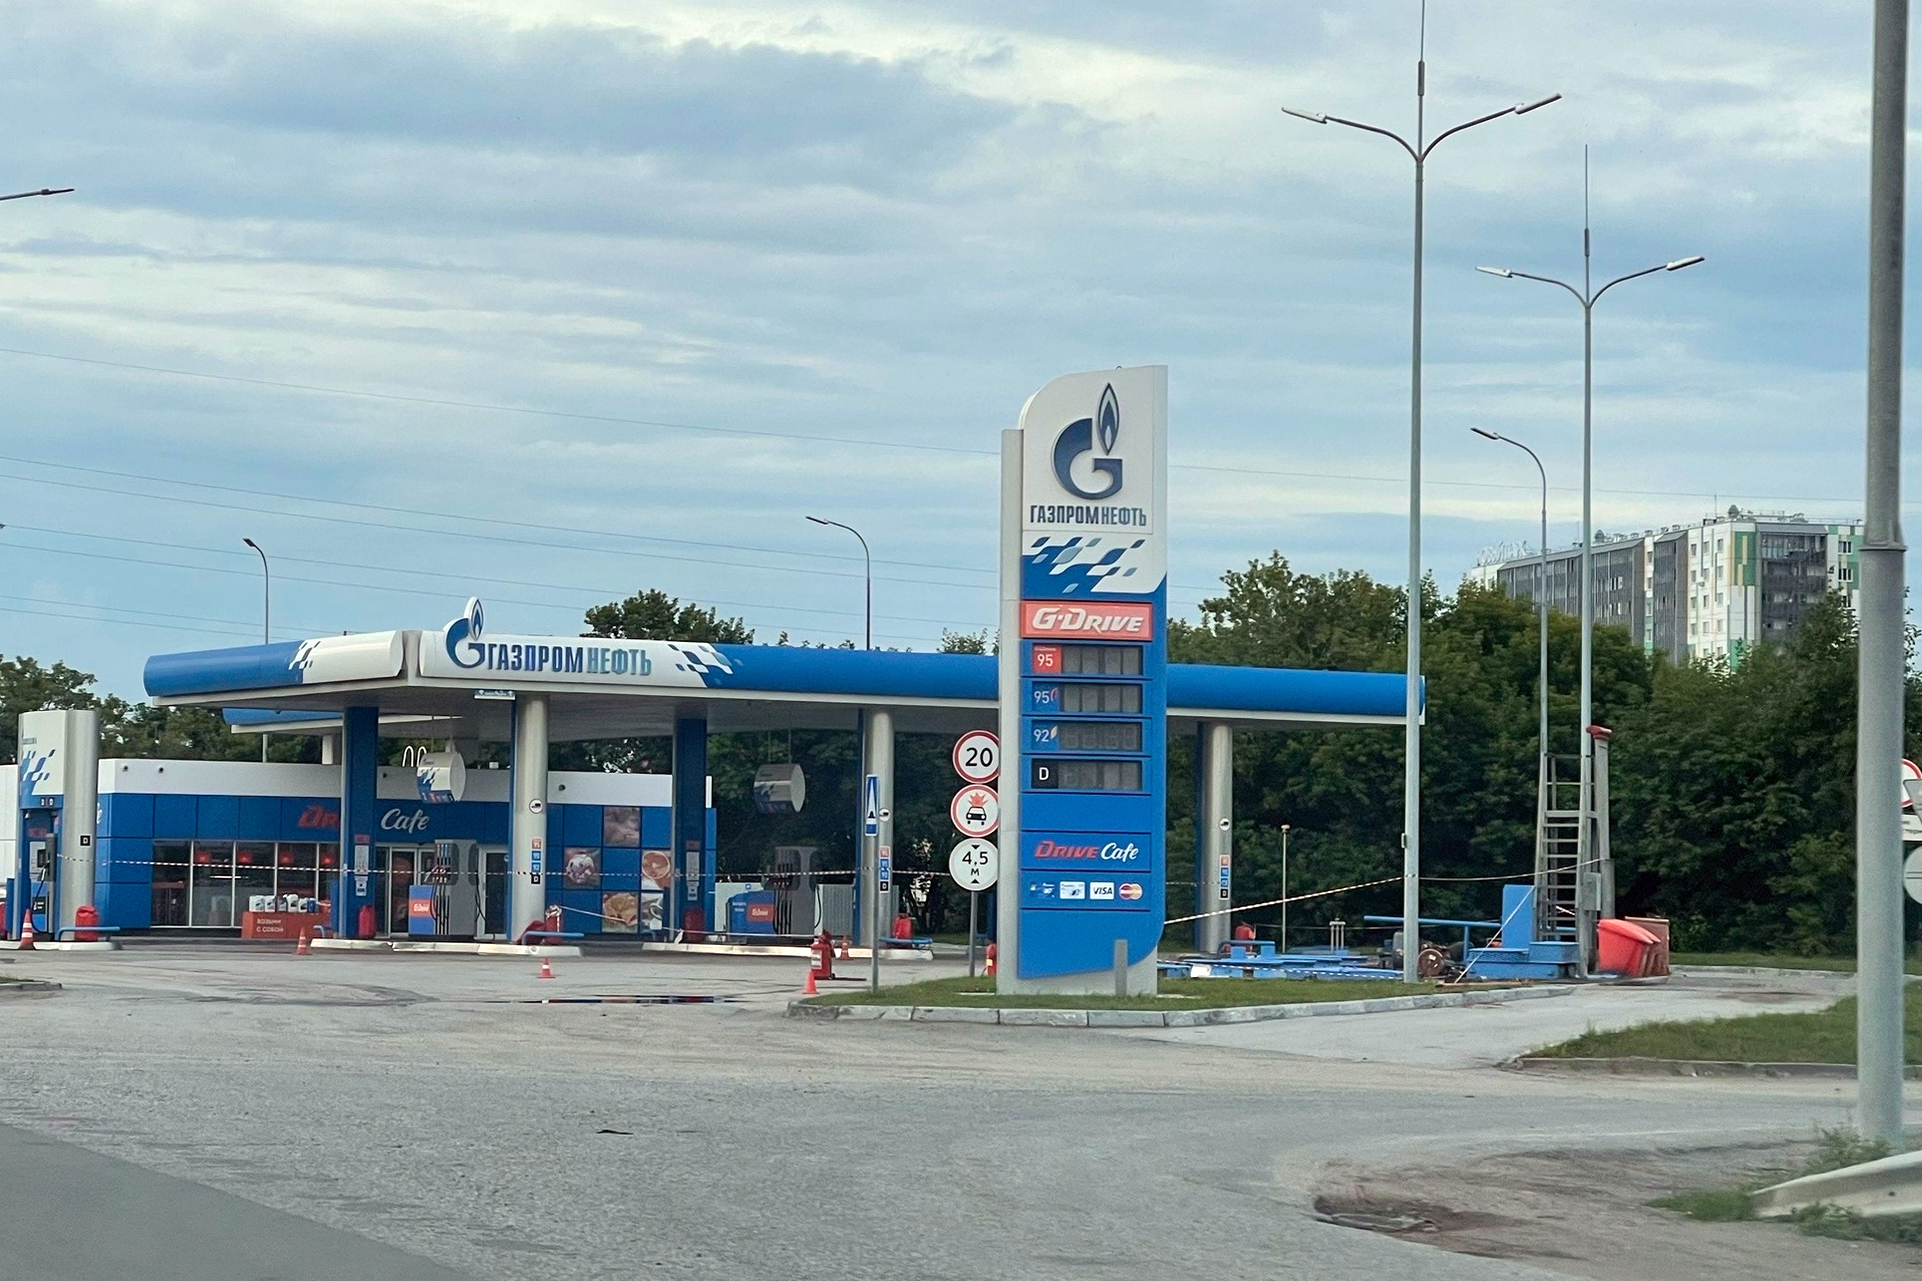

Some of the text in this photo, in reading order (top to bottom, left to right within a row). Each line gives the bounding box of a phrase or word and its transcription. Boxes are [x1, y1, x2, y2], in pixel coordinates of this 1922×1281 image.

[1030, 505, 1147, 526] ГАЗПРОМНЕФТЬ
[487, 643, 652, 676] ГАЗПРОМНЕФТЬ
[1037, 654, 1053, 666] 95
[1034, 691, 1050, 703] 95
[1034, 729, 1049, 742] 92
[965, 747, 993, 767] 20
[1039, 767, 1049, 780] D
[381, 808, 430, 834] Cafe
[962, 851, 988, 867] 4,5
[1100, 842, 1139, 862] Cafe
[1093, 887, 1113, 895] VISA
